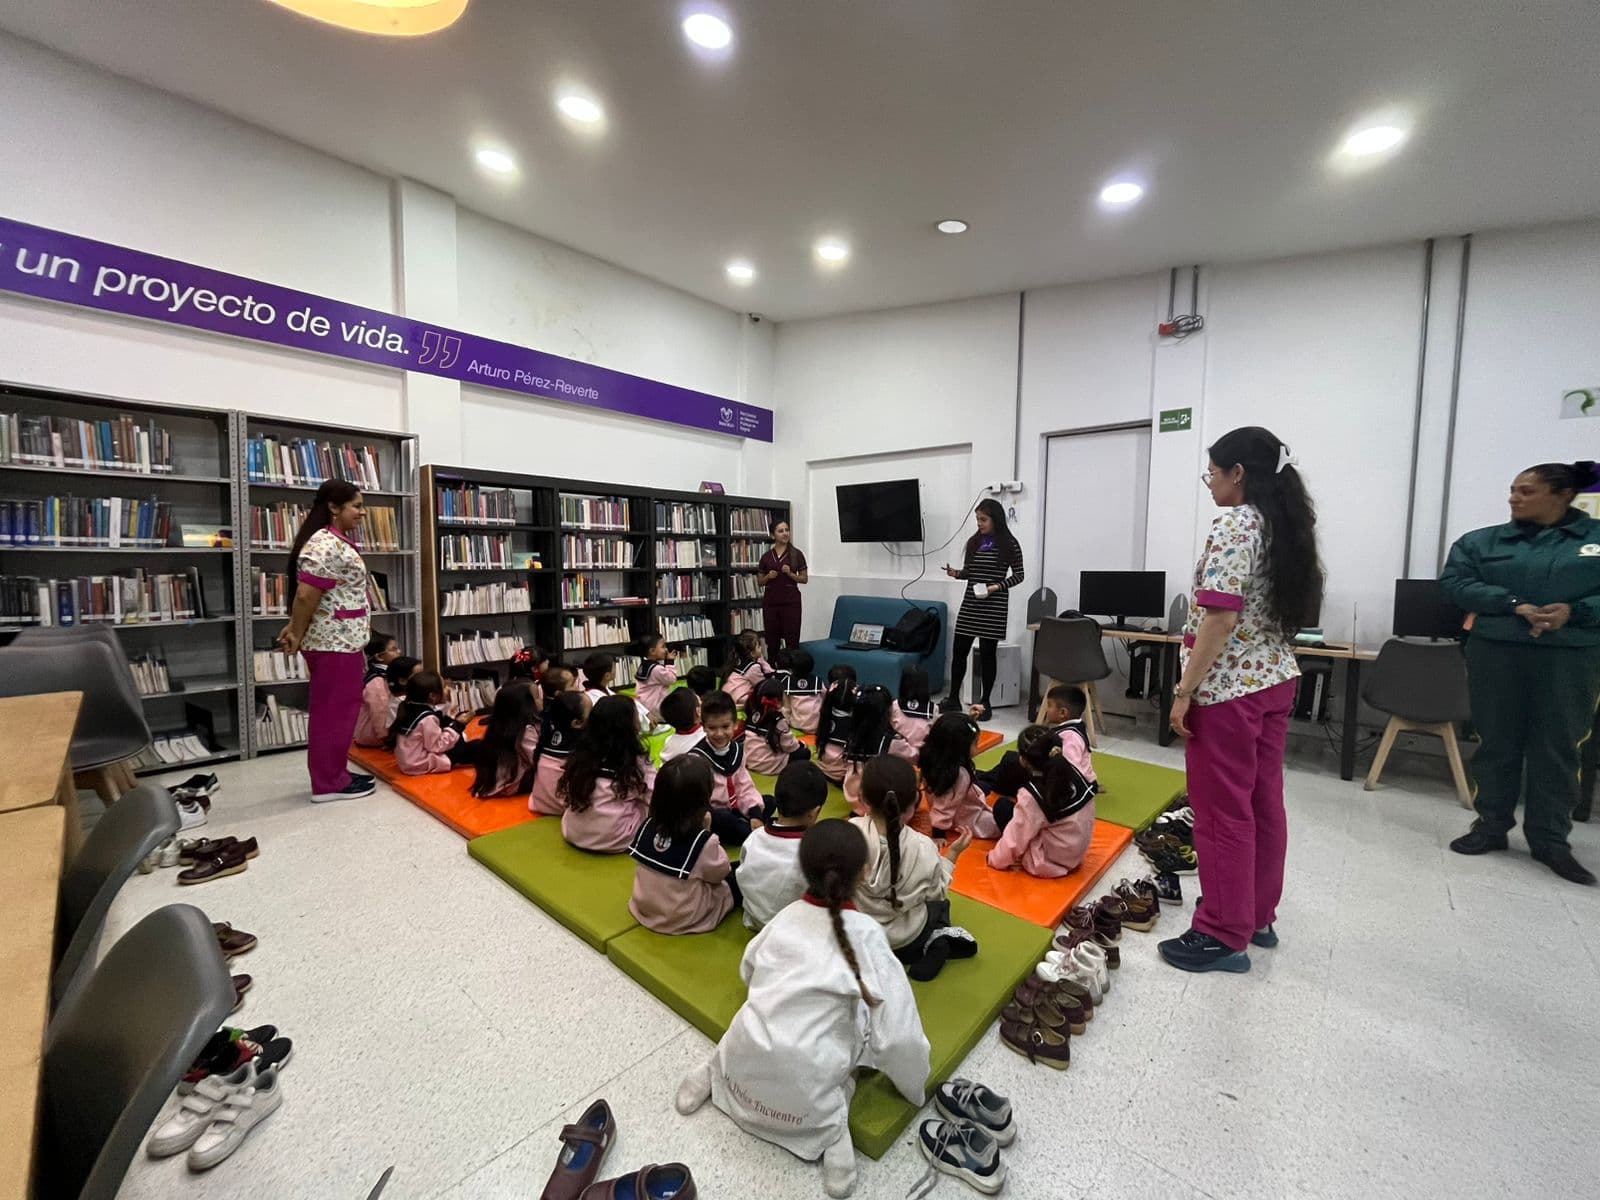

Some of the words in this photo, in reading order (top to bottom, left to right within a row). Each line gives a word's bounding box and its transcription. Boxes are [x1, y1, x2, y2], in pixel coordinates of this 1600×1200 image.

[15, 247, 80, 284] un
[93, 265, 277, 325] proyecto
[286, 306, 331, 338] de
[340, 319, 410, 355] vida.
[467, 360, 511, 380] Arturo
[515, 369, 598, 399] Pérez-Reverte
